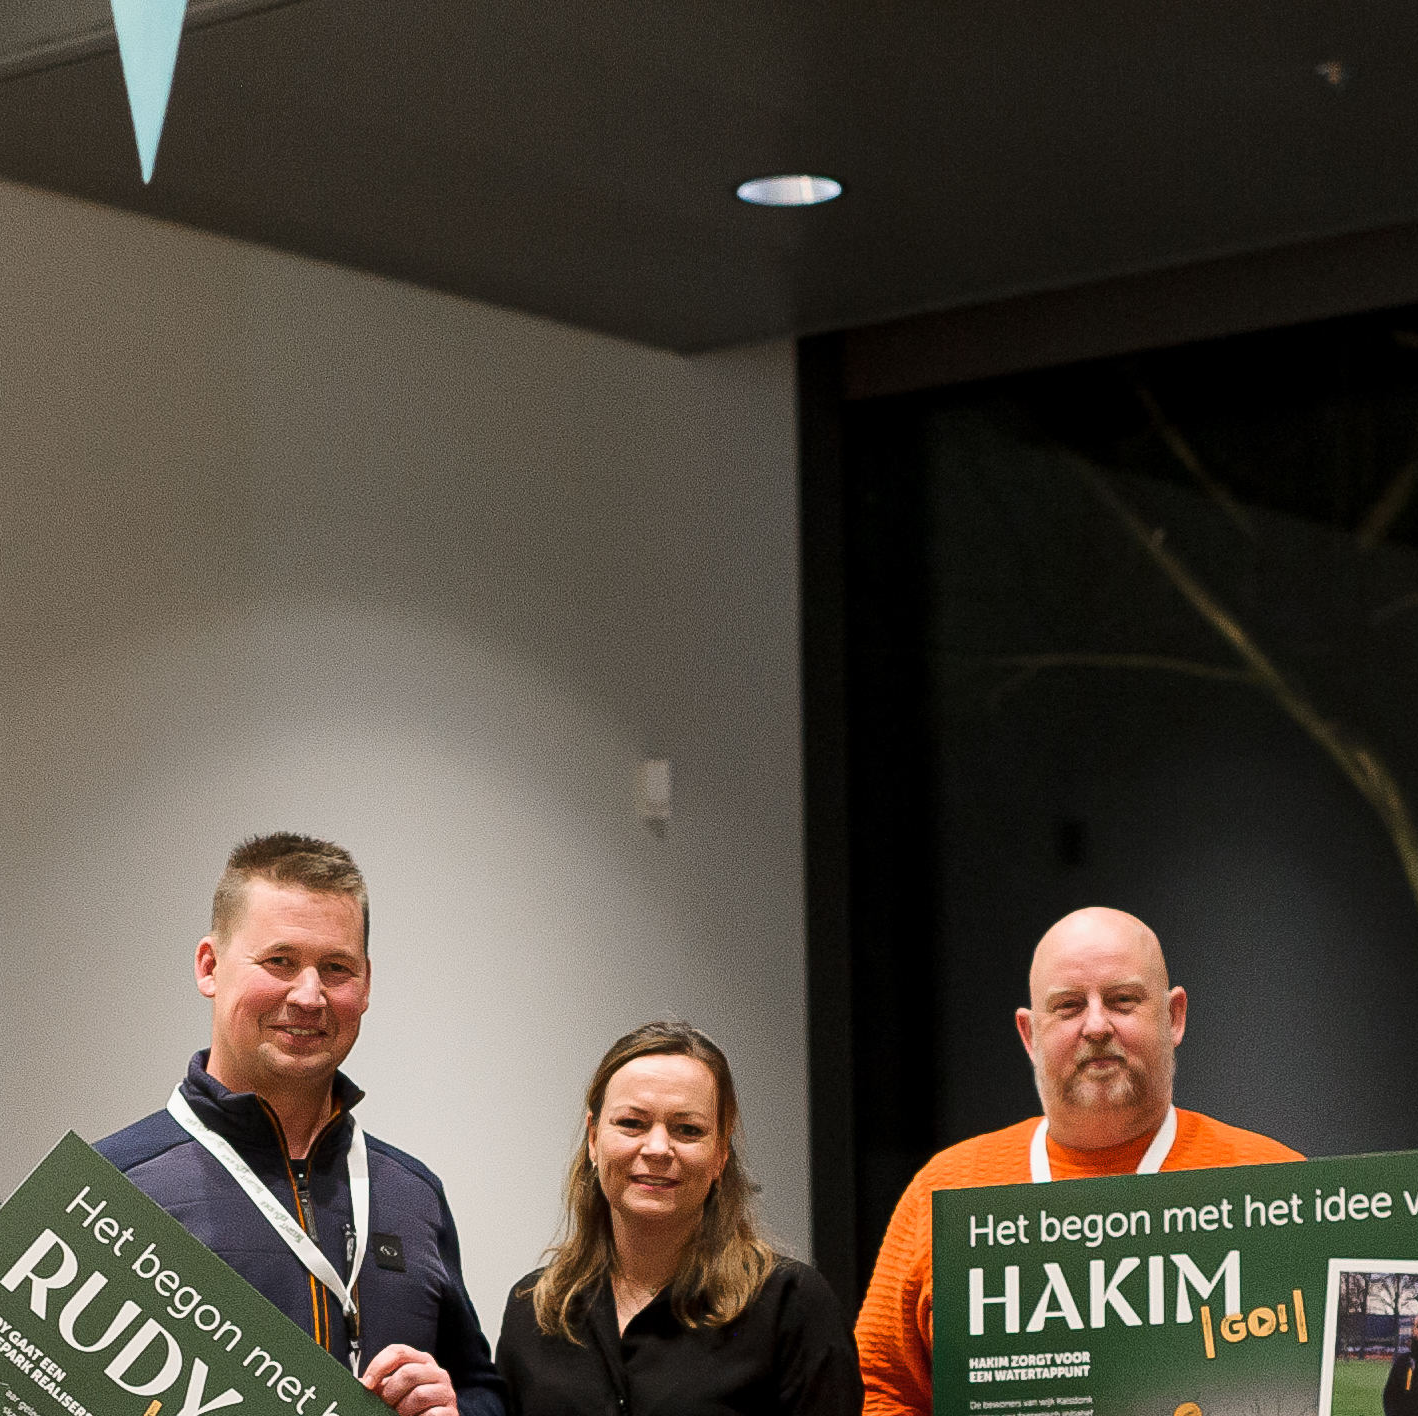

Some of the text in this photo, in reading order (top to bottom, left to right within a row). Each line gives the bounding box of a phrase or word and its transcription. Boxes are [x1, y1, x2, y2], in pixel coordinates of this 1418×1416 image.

[970, 1214, 1030, 1248] Het
[1040, 1210, 1151, 1248] begon
[1163, 1198, 1233, 1234] met
[1244, 1193, 1302, 1228] het
[1315, 1186, 1393, 1222] idee
[65, 1185, 134, 1257] Het
[131, 1242, 242, 1352] begon
[242, 1346, 317, 1415] met
[969, 1249, 1243, 1336] HAKIM
[8, 1330, 45, 1361] GAAT
[39, 1356, 67, 1383] EEN
[968, 1351, 1091, 1370] HAKIM ZORGT VOOR
[969, 1364, 1091, 1383] EEN WATERTAPPUNT
